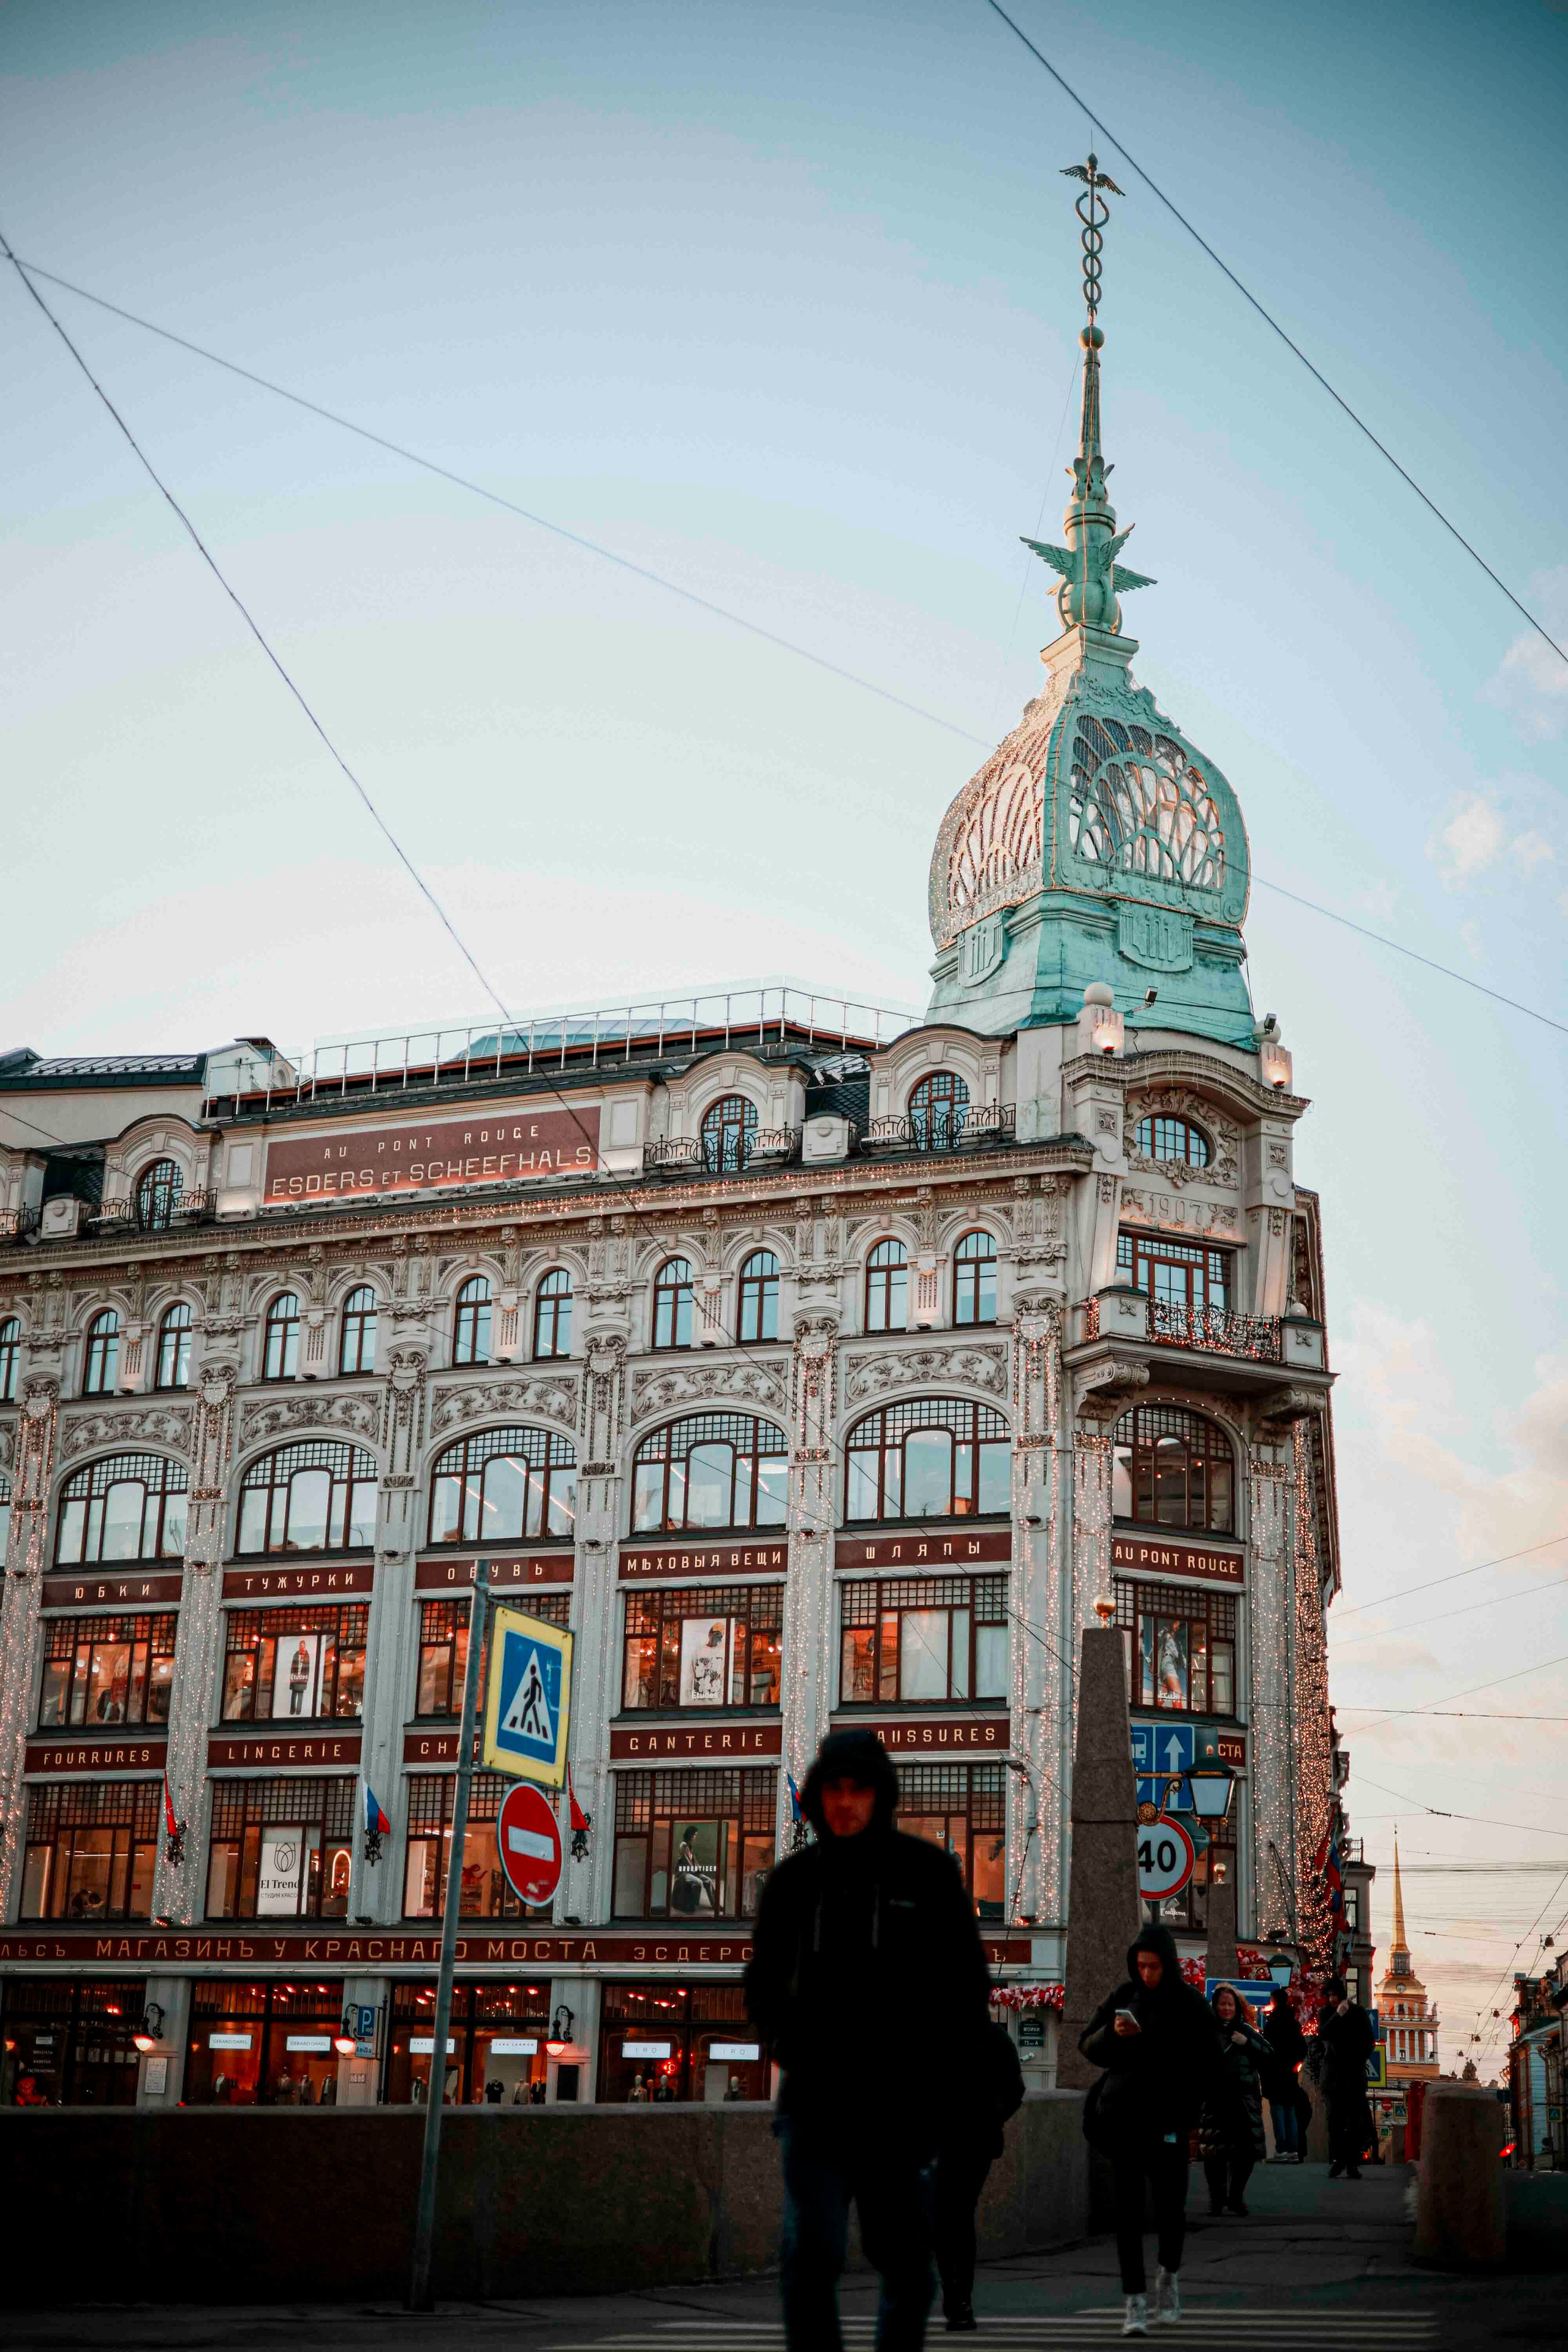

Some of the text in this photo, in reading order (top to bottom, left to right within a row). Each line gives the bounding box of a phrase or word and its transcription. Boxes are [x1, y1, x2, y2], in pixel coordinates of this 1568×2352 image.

[324, 1125, 540, 1159] AU PONT ROUGE
[272, 1147, 592, 1197] ESDERS ET SCHEEFHALS
[1149, 1194, 1203, 1226] 1907
[731, 1551, 781, 1566] ВЕЩИ
[865, 1541, 980, 1559] ШЛЯПЫ
[1115, 1545, 1238, 1574] AU PONT ROUGE
[448, 1563, 543, 1580] ОБУВЬ
[246, 1573, 353, 1591] ТУЖУРКИ
[75, 1584, 149, 1599] ЮБКИ
[43, 1749, 151, 1766] FOURRURES
[1138, 1840, 1177, 1873] 40
[260, 1879, 270, 1888] El
[96, 1939, 254, 1958] МАГАЗИНЪ
[274, 1940, 286, 1958] У
[306, 1940, 467, 1959] КРАСНАГО
[488, 1940, 597, 1961] МОСТА
